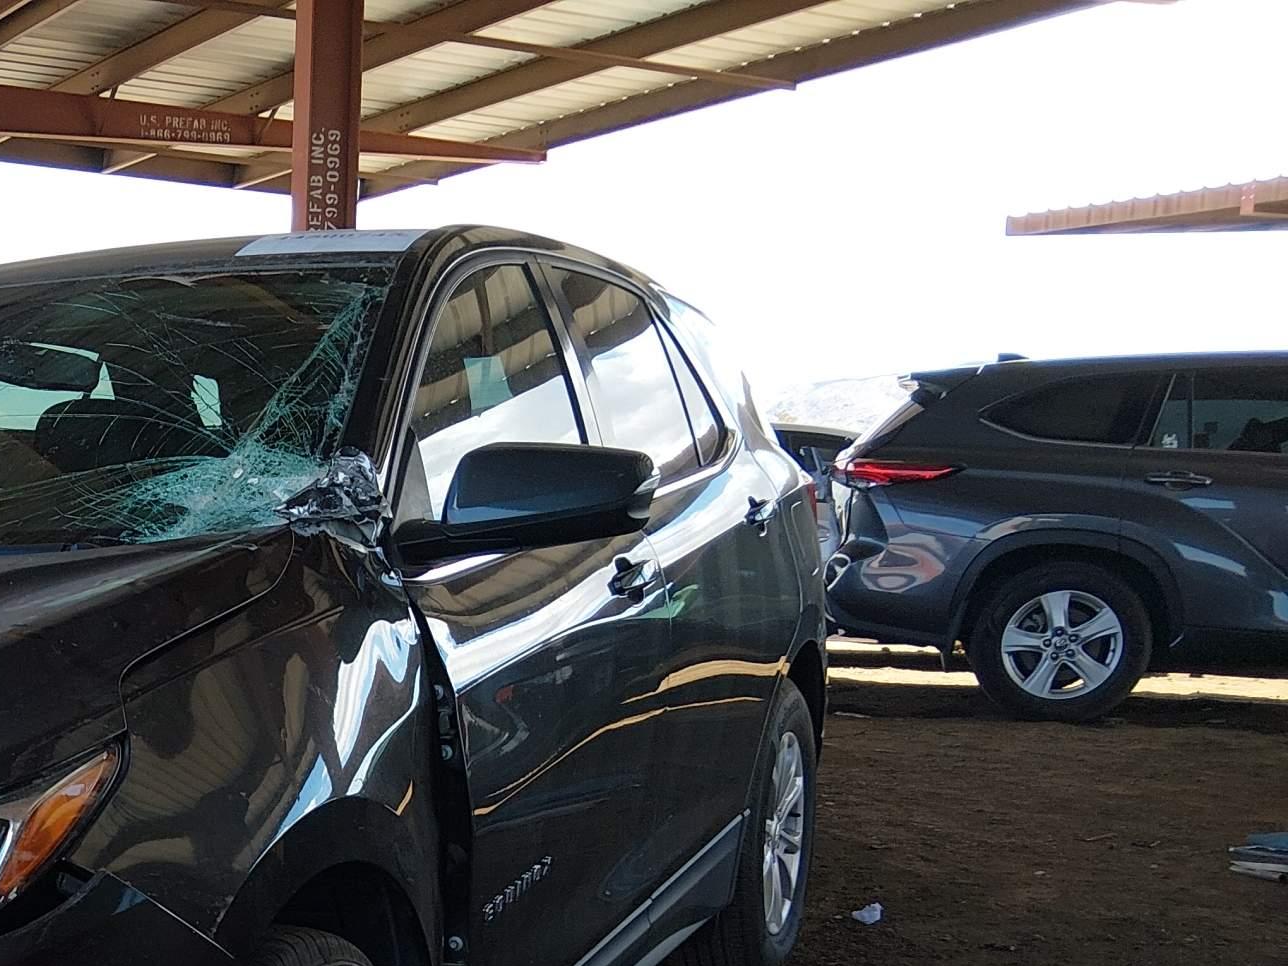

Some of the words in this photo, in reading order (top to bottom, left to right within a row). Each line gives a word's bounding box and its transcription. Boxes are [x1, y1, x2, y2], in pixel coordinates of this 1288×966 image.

[139, 114, 161, 127] U.S.
[165, 116, 206, 130] PREFAB
[210, 119, 231, 132] INC.
[140, 127, 231, 143] 1-866-799-0969
[311, 127, 325, 164] INC.
